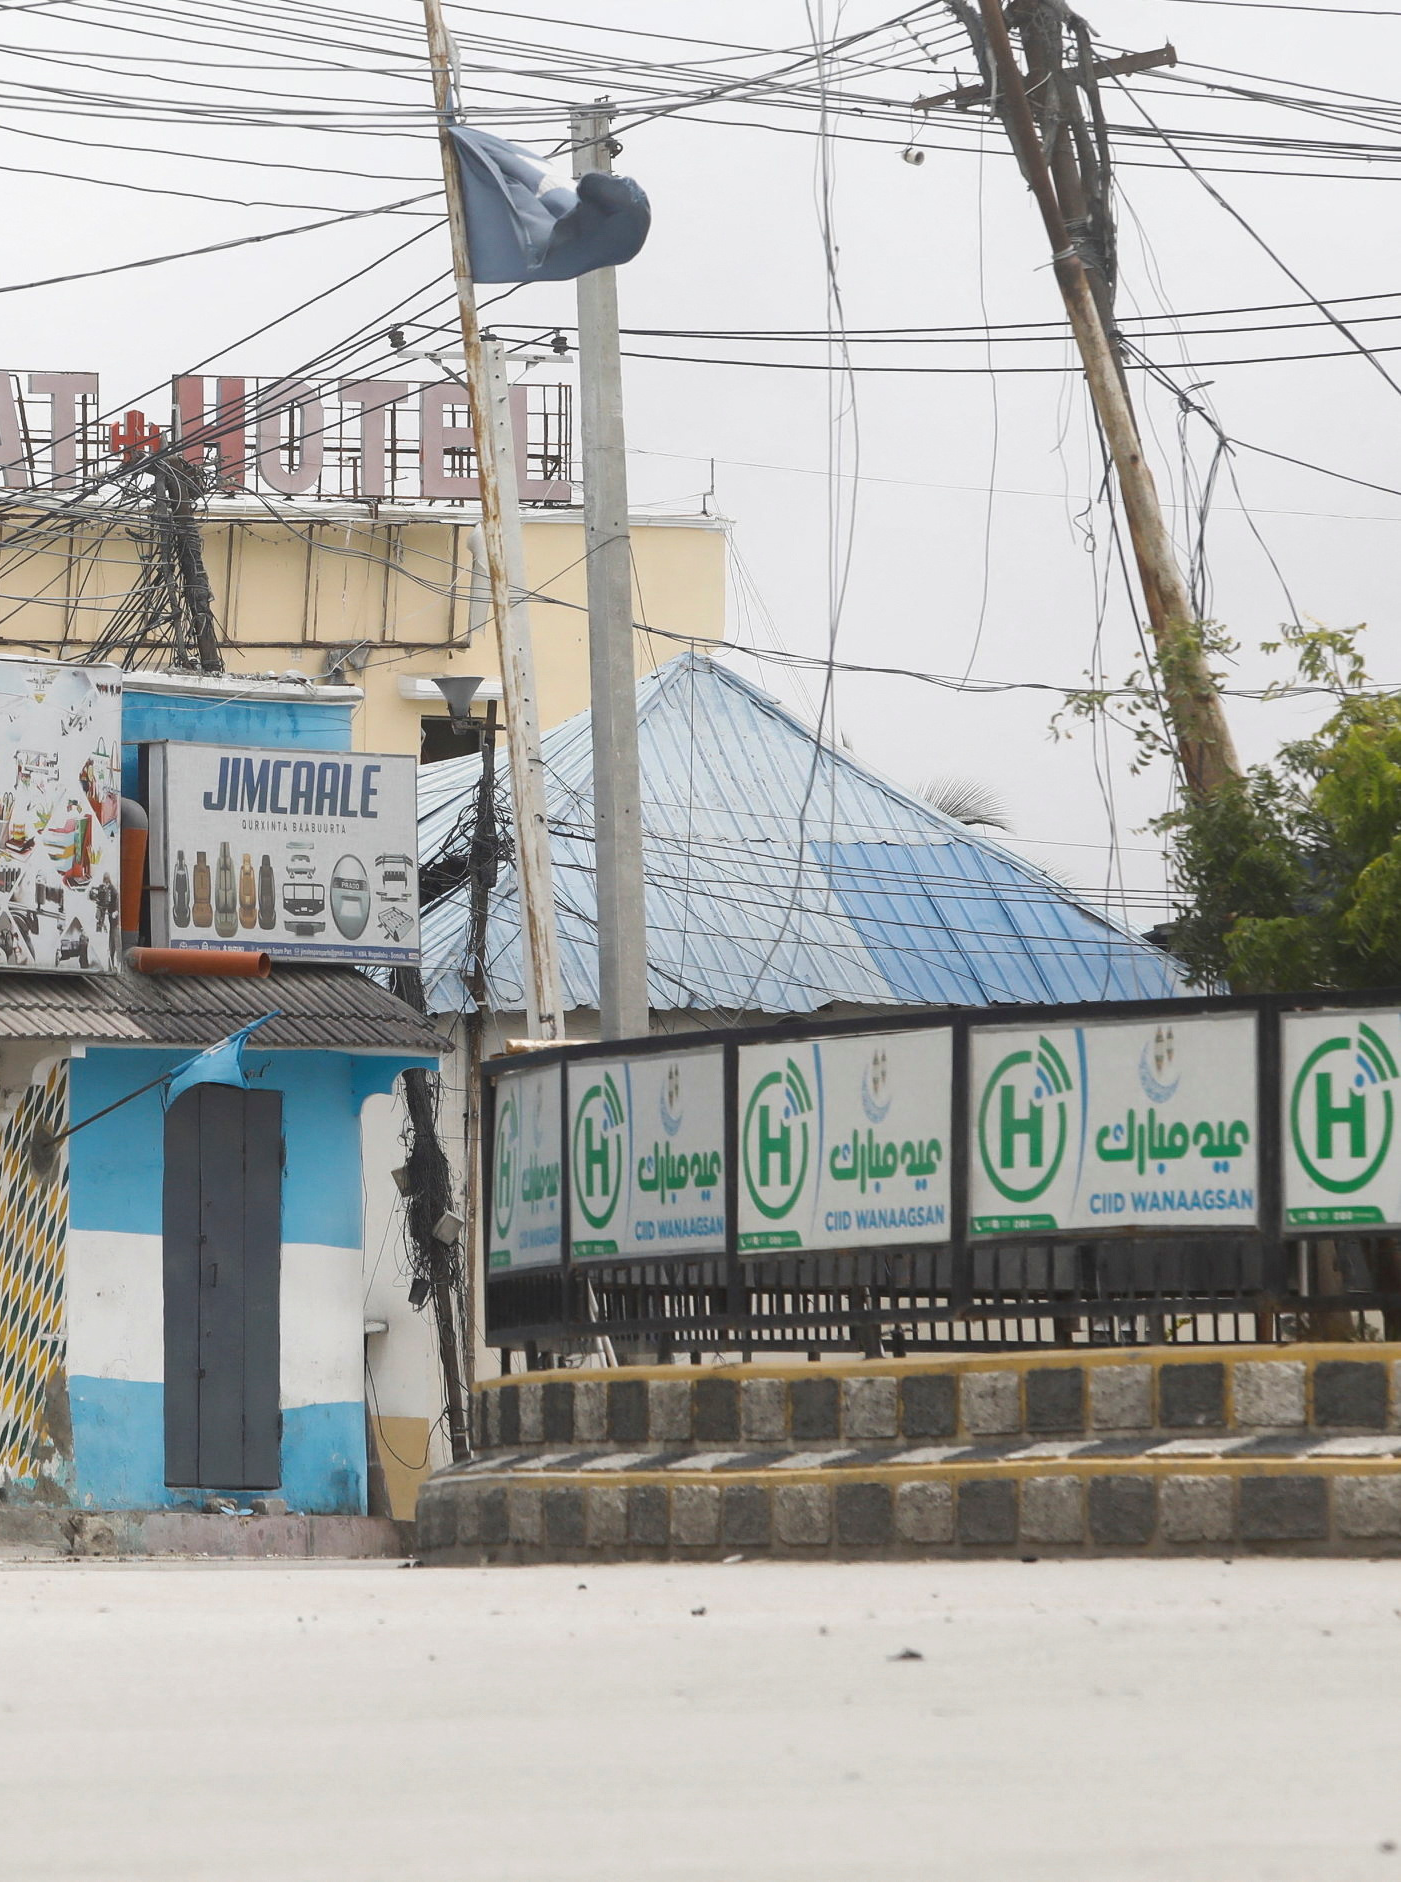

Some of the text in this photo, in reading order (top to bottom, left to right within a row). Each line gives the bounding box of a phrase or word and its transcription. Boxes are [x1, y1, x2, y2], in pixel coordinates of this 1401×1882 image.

[174, 376, 572, 503] HOTEL
[202, 756, 382, 819] JIMCAALE
[241, 819, 347, 834] QURXINTA BAABUURTA
[759, 1105, 791, 1187] H
[1000, 1084, 1043, 1169] H
[1096, 1107, 1250, 1176] عيد مبارك
[1315, 1072, 1367, 1160] H
[585, 1116, 610, 1198] H
[638, 1140, 722, 1205] عيد مبارك
[829, 1128, 943, 1195] عيد مبارك
[635, 1220, 656, 1241] CIID
[657, 1215, 725, 1240] WANAAGSAN
[824, 1204, 945, 1232] CIID WANAAGSAN
[1089, 1188, 1254, 1214] CIID WANAAGSAN
